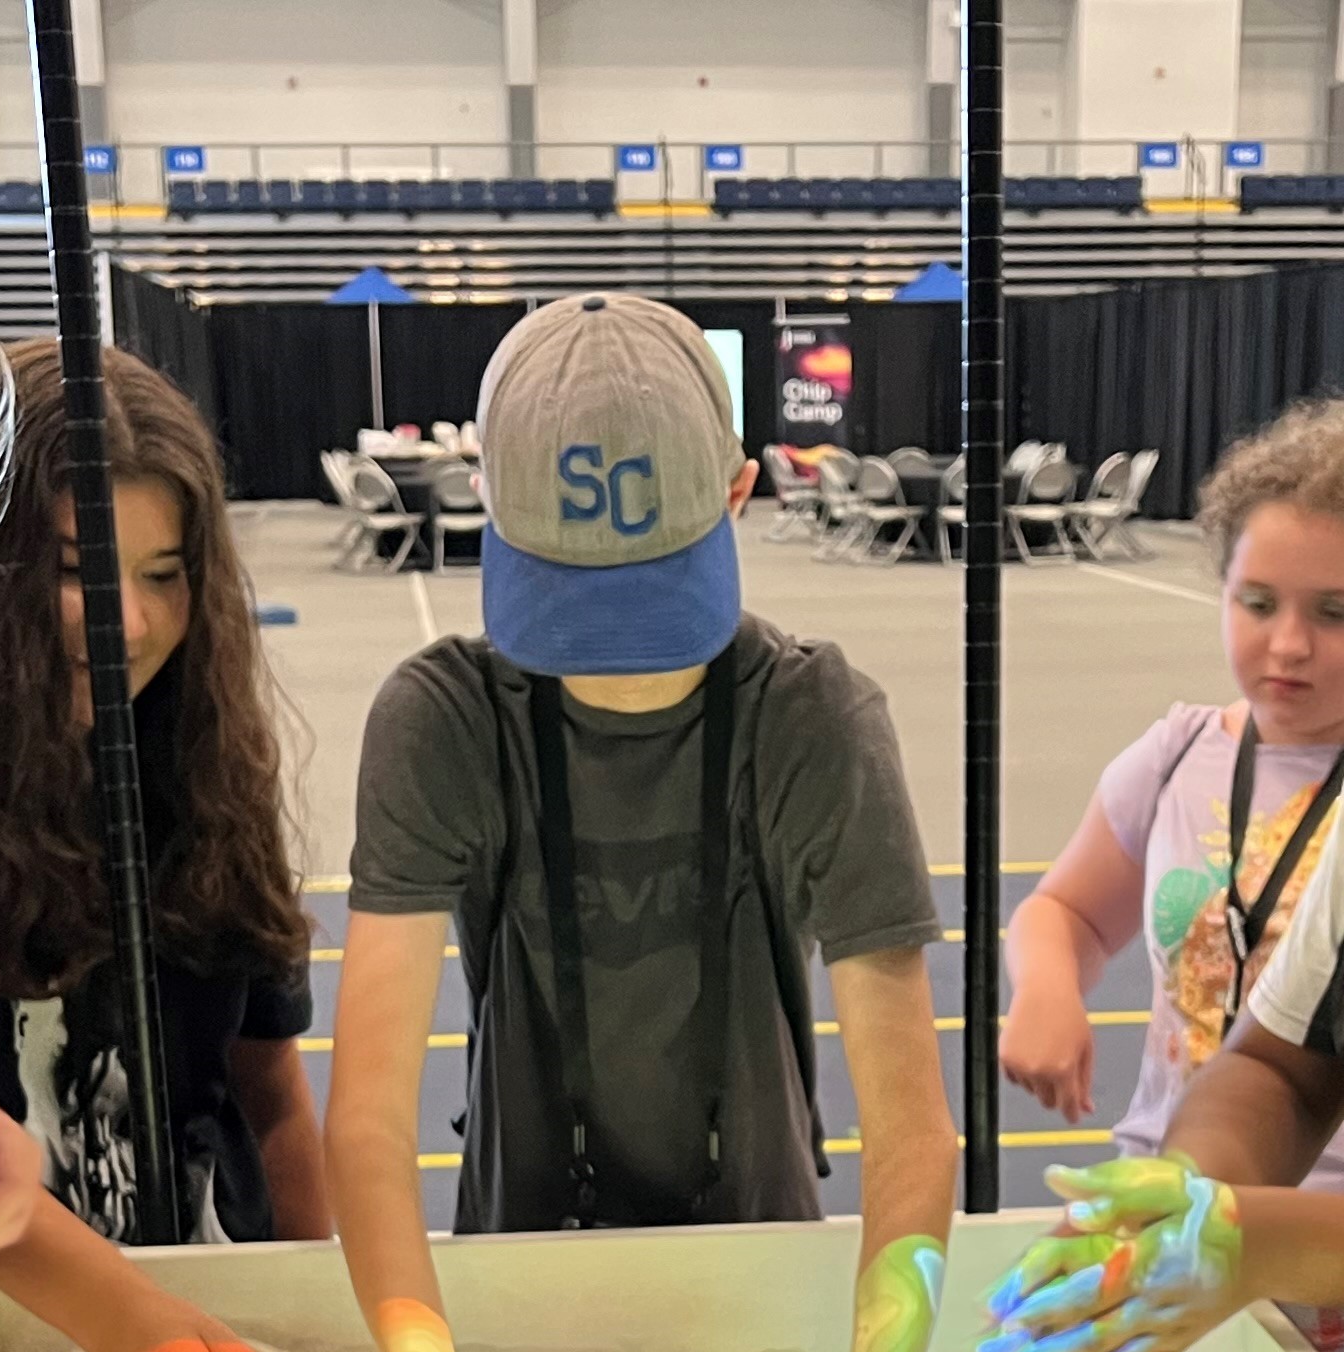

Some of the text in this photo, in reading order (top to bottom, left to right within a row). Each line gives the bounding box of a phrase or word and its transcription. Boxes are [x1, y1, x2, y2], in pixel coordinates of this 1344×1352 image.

[783, 378, 832, 402] Chip
[783, 401, 843, 426] Camp
[559, 444, 657, 536] SC
